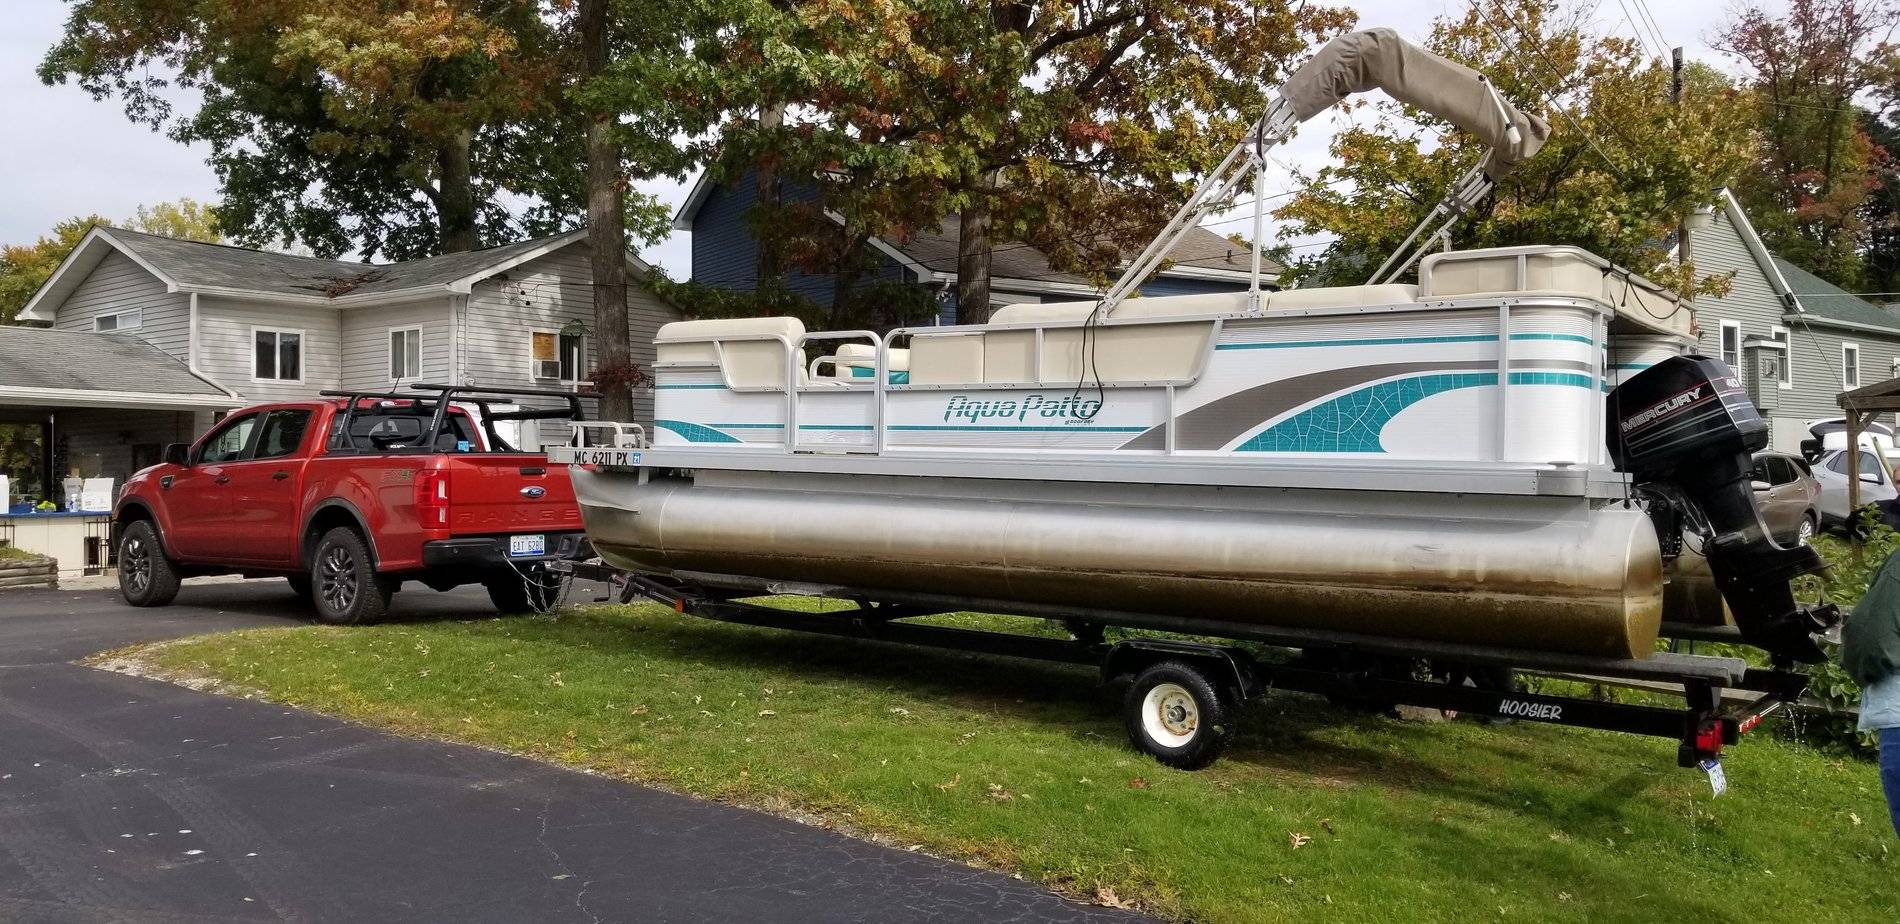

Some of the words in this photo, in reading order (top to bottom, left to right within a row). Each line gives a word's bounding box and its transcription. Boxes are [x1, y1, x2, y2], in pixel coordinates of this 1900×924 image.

[943, 395, 1017, 423] Aqua
[1620, 387, 1701, 433] MERCURY
[574, 450, 588, 464] MC
[591, 451, 612, 465] 6211
[616, 451, 628, 466] PX
[457, 509, 579, 523] RANGE
[1499, 699, 1562, 720] HOOSIER
